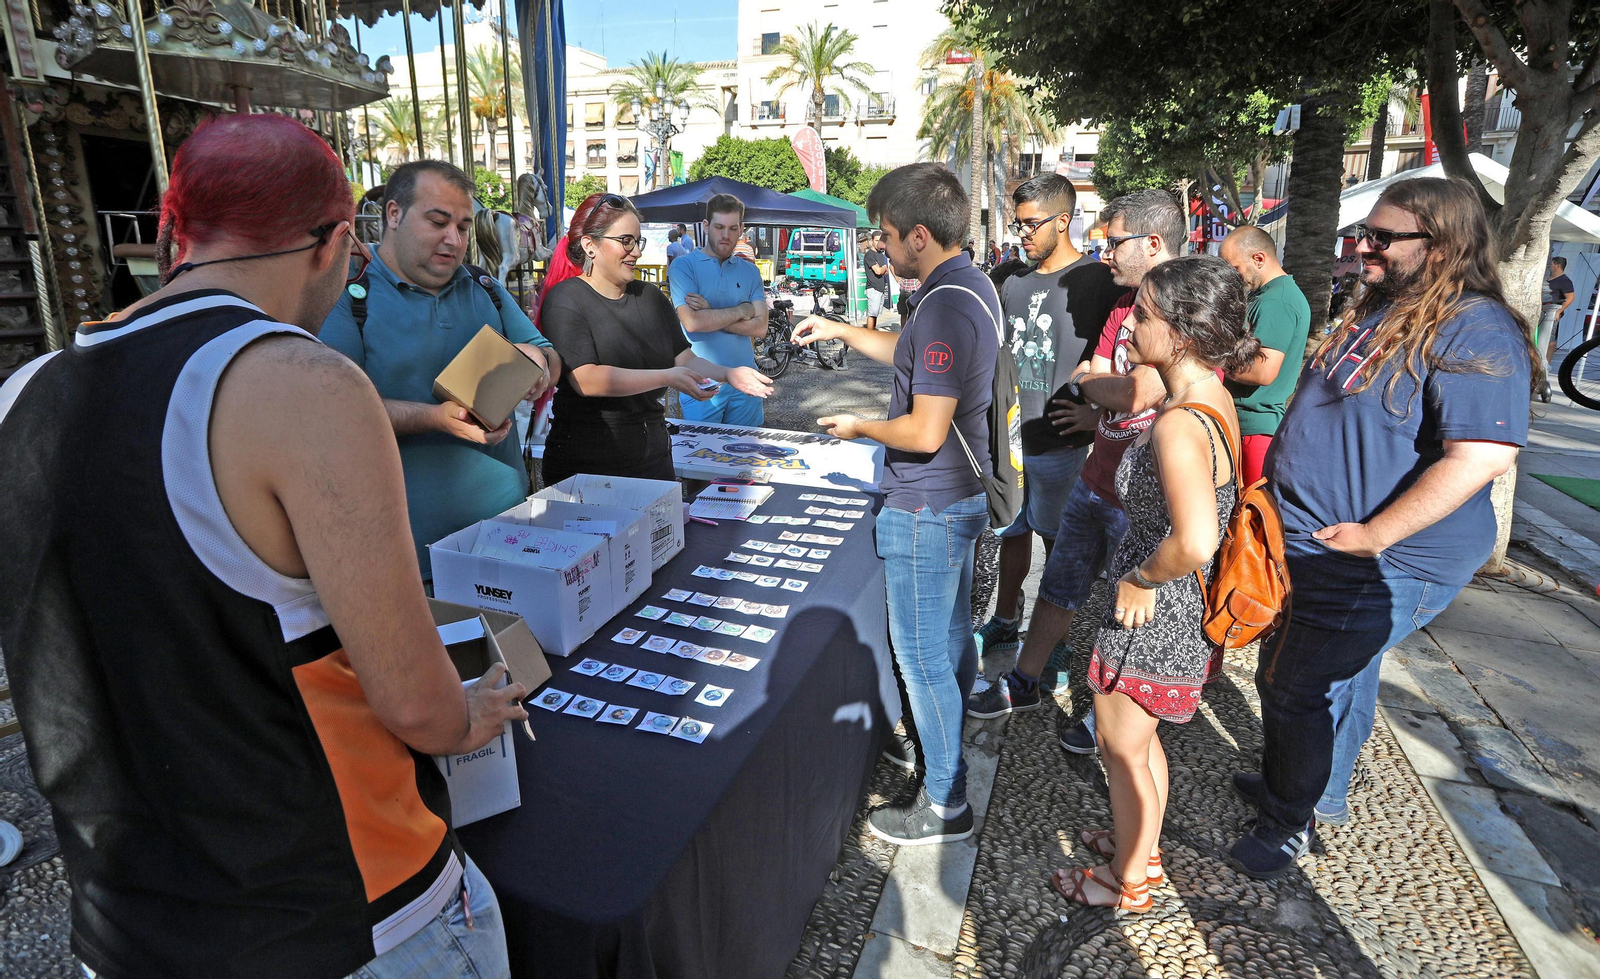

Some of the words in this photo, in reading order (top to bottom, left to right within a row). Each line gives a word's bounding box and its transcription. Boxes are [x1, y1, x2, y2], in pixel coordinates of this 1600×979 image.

[928, 351, 949, 366] TP
[1018, 380, 1050, 393] NTISTS
[474, 583, 514, 600] YUNSEY
[477, 594, 512, 605] PROFESSIONAL
[456, 747, 496, 766] FRAGIL
